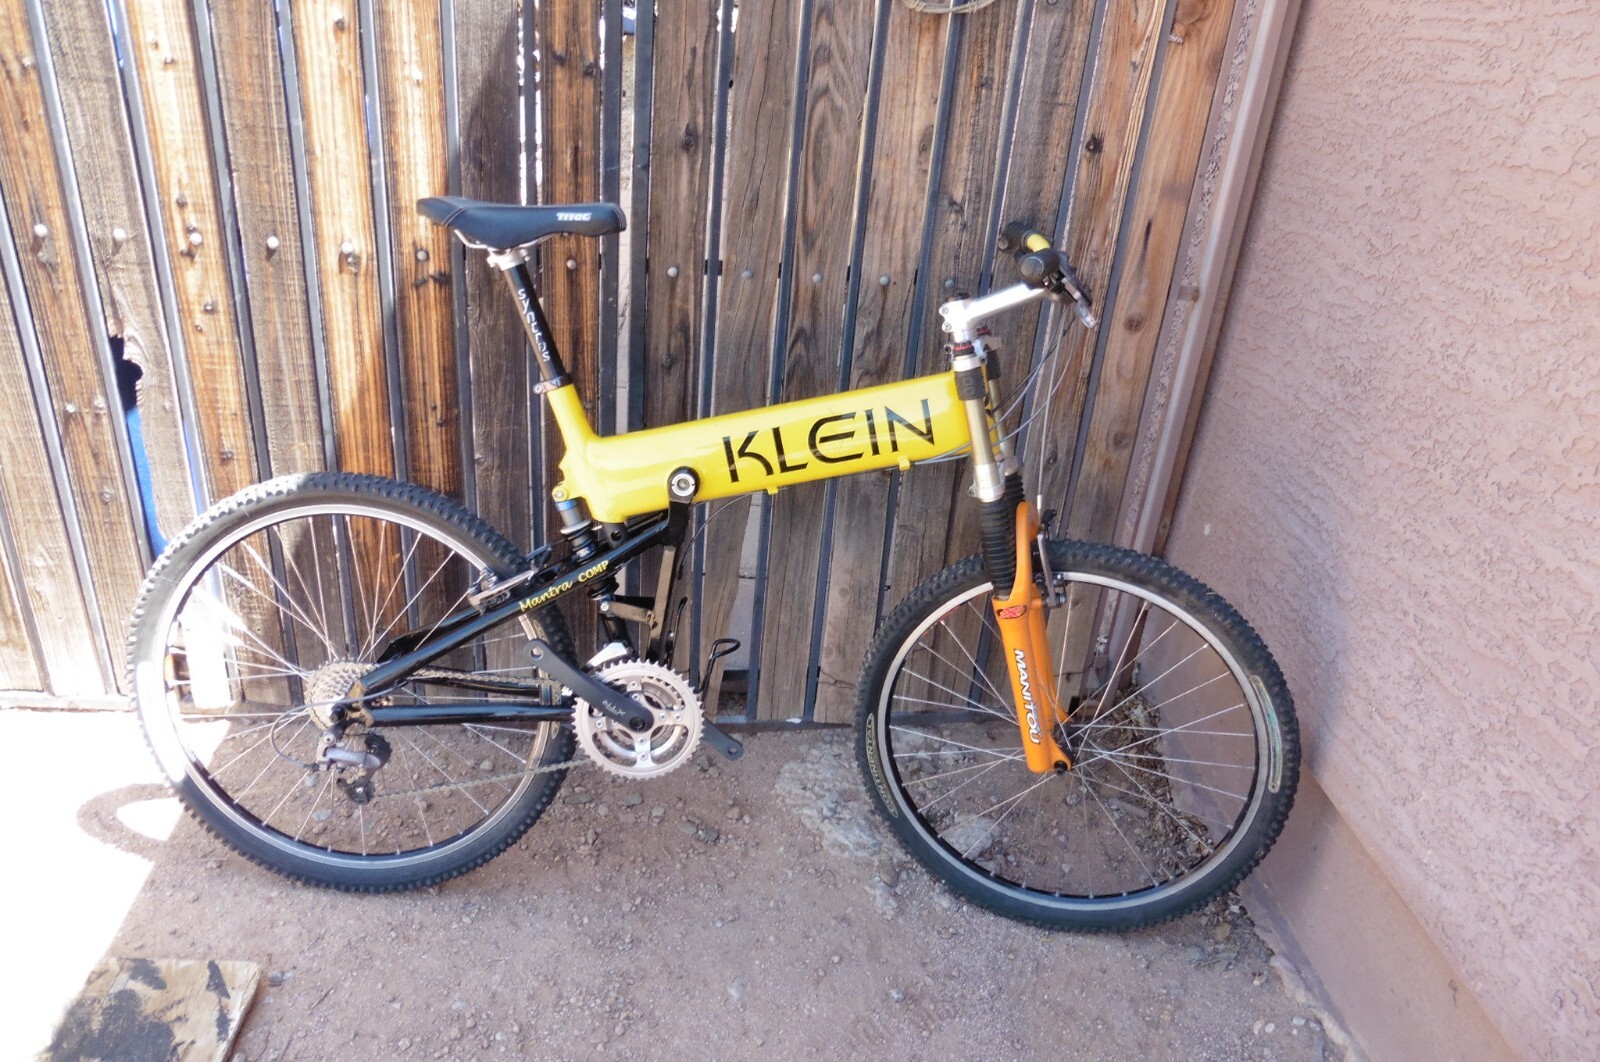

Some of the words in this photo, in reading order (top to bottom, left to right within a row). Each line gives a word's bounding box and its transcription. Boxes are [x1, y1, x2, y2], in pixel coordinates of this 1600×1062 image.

[721, 398, 935, 483] KLEIN
[519, 580, 573, 612] Mantra
[577, 560, 609, 582] COMP
[1014, 648, 1042, 744] MANITOU
